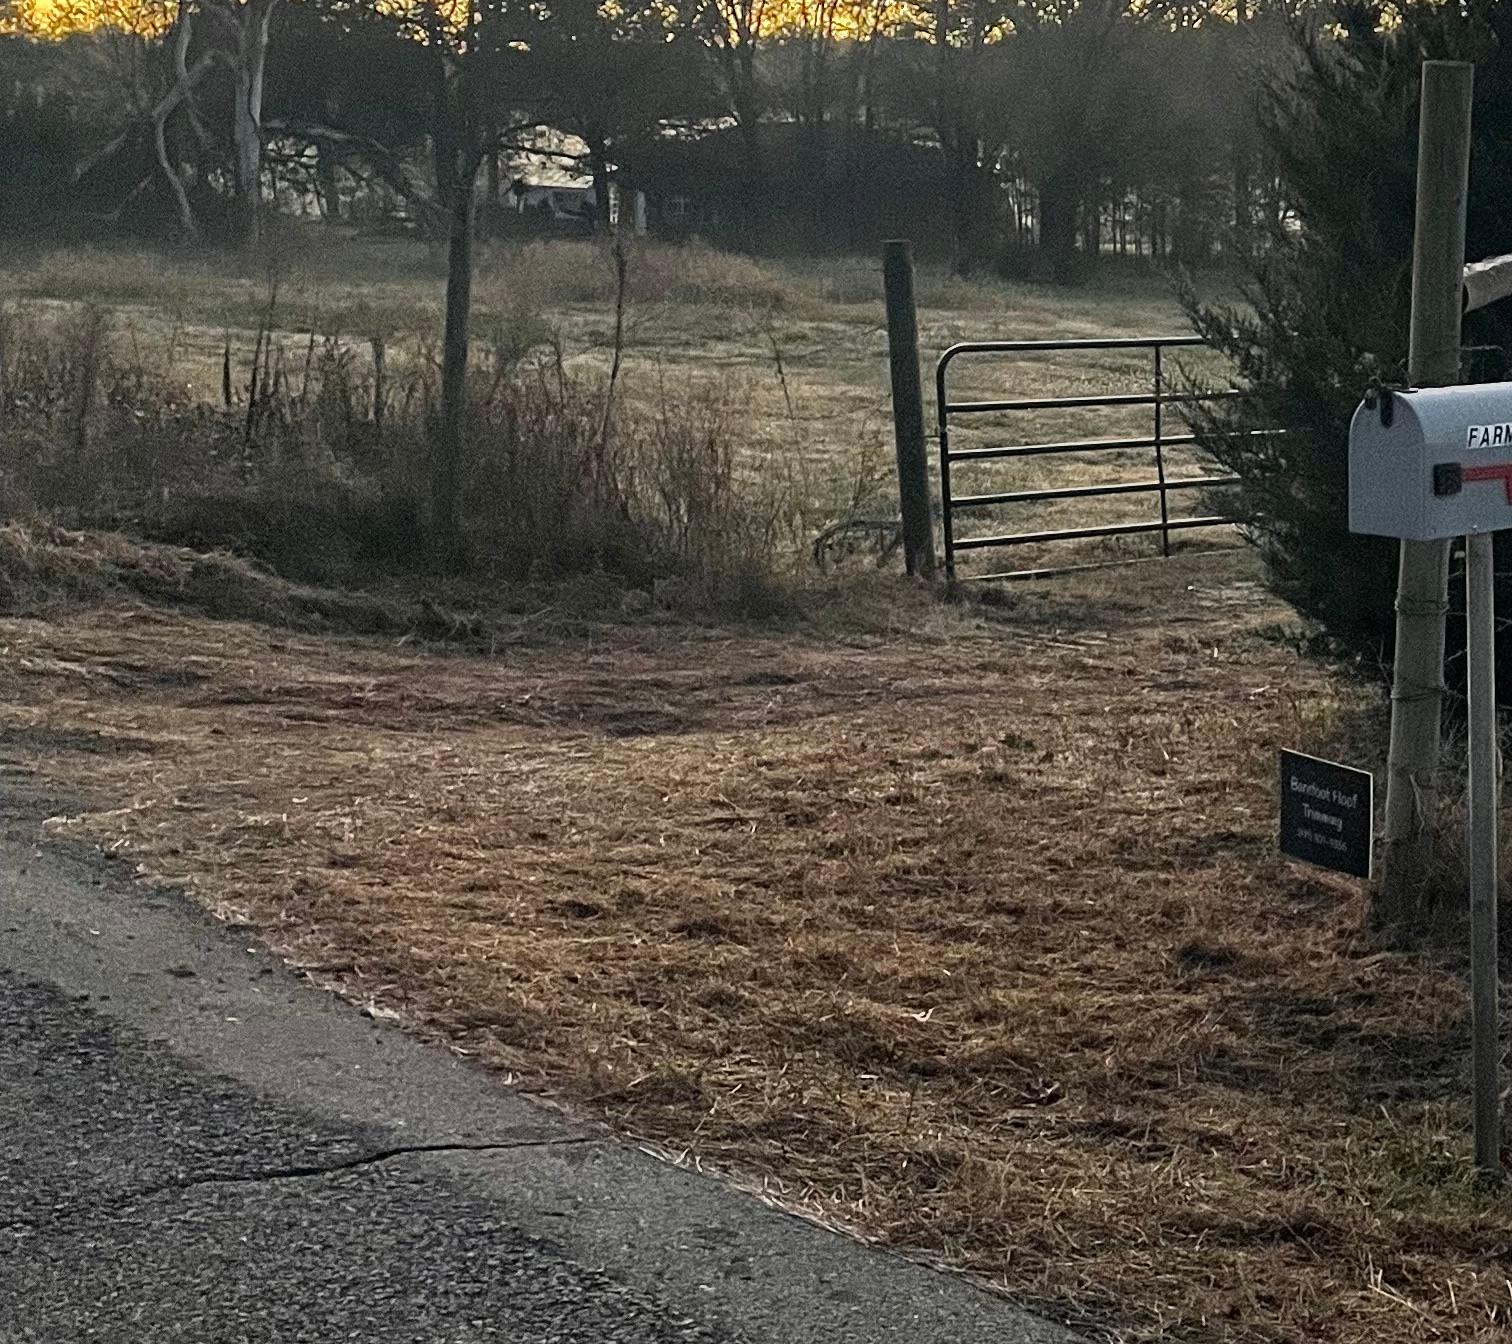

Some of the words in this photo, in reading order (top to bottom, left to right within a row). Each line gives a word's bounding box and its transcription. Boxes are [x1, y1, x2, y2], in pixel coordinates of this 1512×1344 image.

[1290, 776, 1329, 802] Barefoot
[1332, 789, 1358, 808] Hoof
[1302, 802, 1342, 832] Trimming
